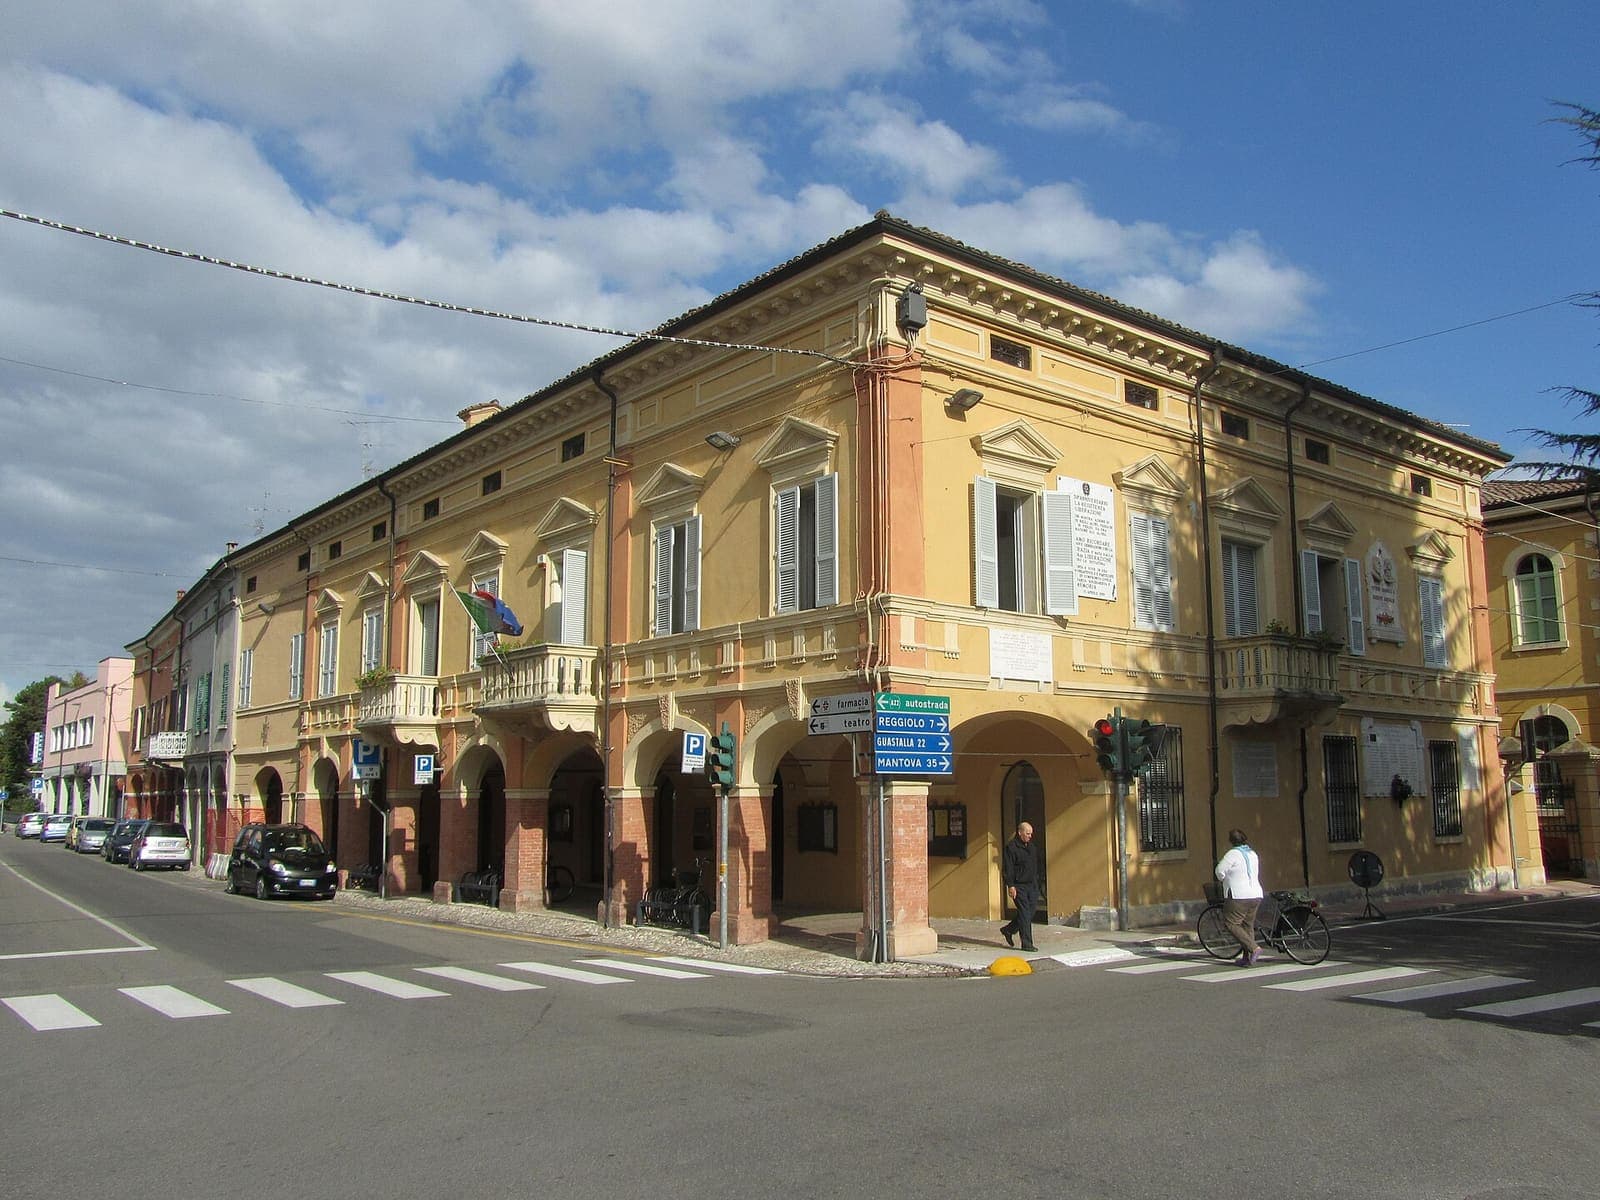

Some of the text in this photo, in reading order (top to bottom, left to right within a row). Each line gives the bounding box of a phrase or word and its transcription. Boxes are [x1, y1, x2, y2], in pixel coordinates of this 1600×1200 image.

[837, 697, 869, 709] farmacia
[905, 700, 949, 710] autostrada
[844, 718, 870, 728] teatro
[879, 717, 935, 729] REGGIOLO 7
[690, 736, 700, 753] P
[877, 737, 926, 748] GUASTALLA 22
[358, 741, 375, 763] P
[419, 758, 429, 770] P
[878, 758, 938, 768] MANTOVA 35
